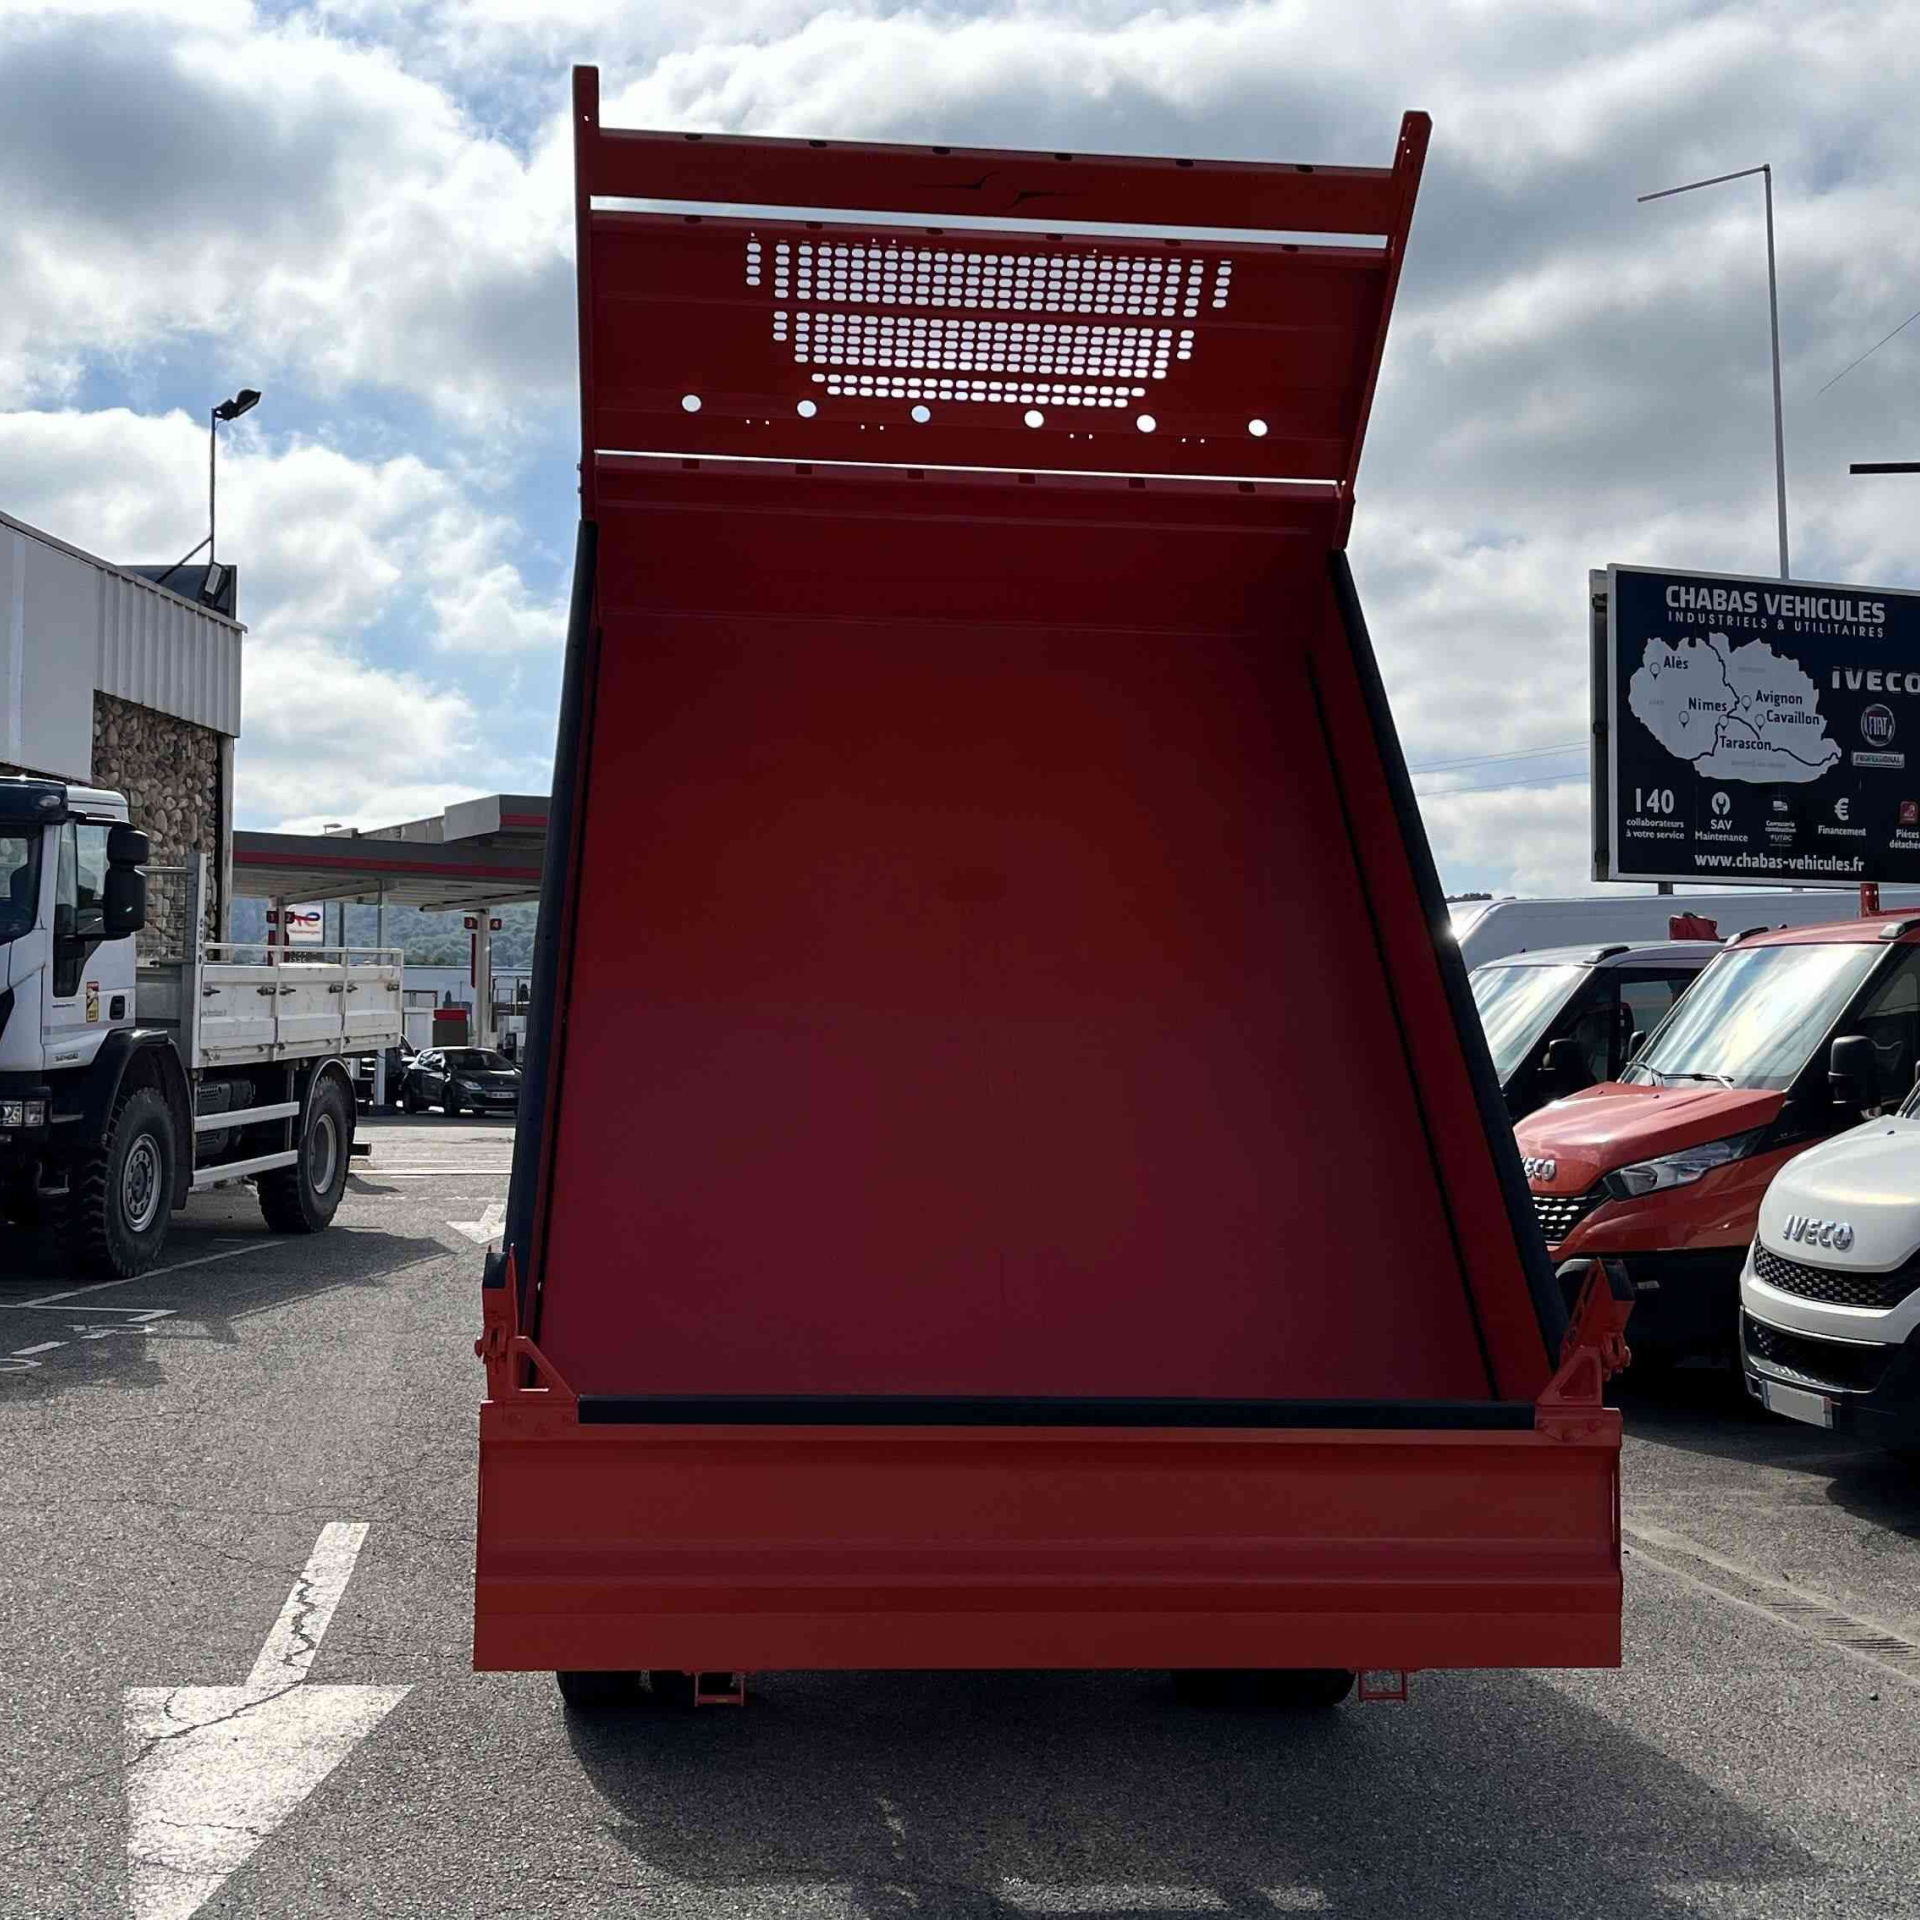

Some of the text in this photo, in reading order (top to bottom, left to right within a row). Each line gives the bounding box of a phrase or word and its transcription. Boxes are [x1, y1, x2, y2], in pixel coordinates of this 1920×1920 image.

[1665, 585, 1886, 624] CHABAS VEHICULES
[1667, 610, 1884, 638] INDUSTRIELS & UTILITAIRES
[1663, 655, 1689, 670] Alès
[1831, 666, 1920, 694] IVECO
[1755, 689, 1803, 707] Avignon
[1766, 709, 1820, 726] Cavaillon
[1719, 735, 1772, 751] Tarascon
[1635, 787, 1675, 814] 140
[1626, 818, 1685, 829] collaborateurs
[1710, 819, 1733, 831] SAV
[1818, 825, 1867, 837] Financement
[1633, 831, 1655, 839] votre
[1656, 831, 1685, 840] service
[1694, 831, 1749, 842] Maintenance
[1694, 852, 1865, 873] www.chabas-vehicules.fr
[1783, 1214, 1854, 1250] IVECO
